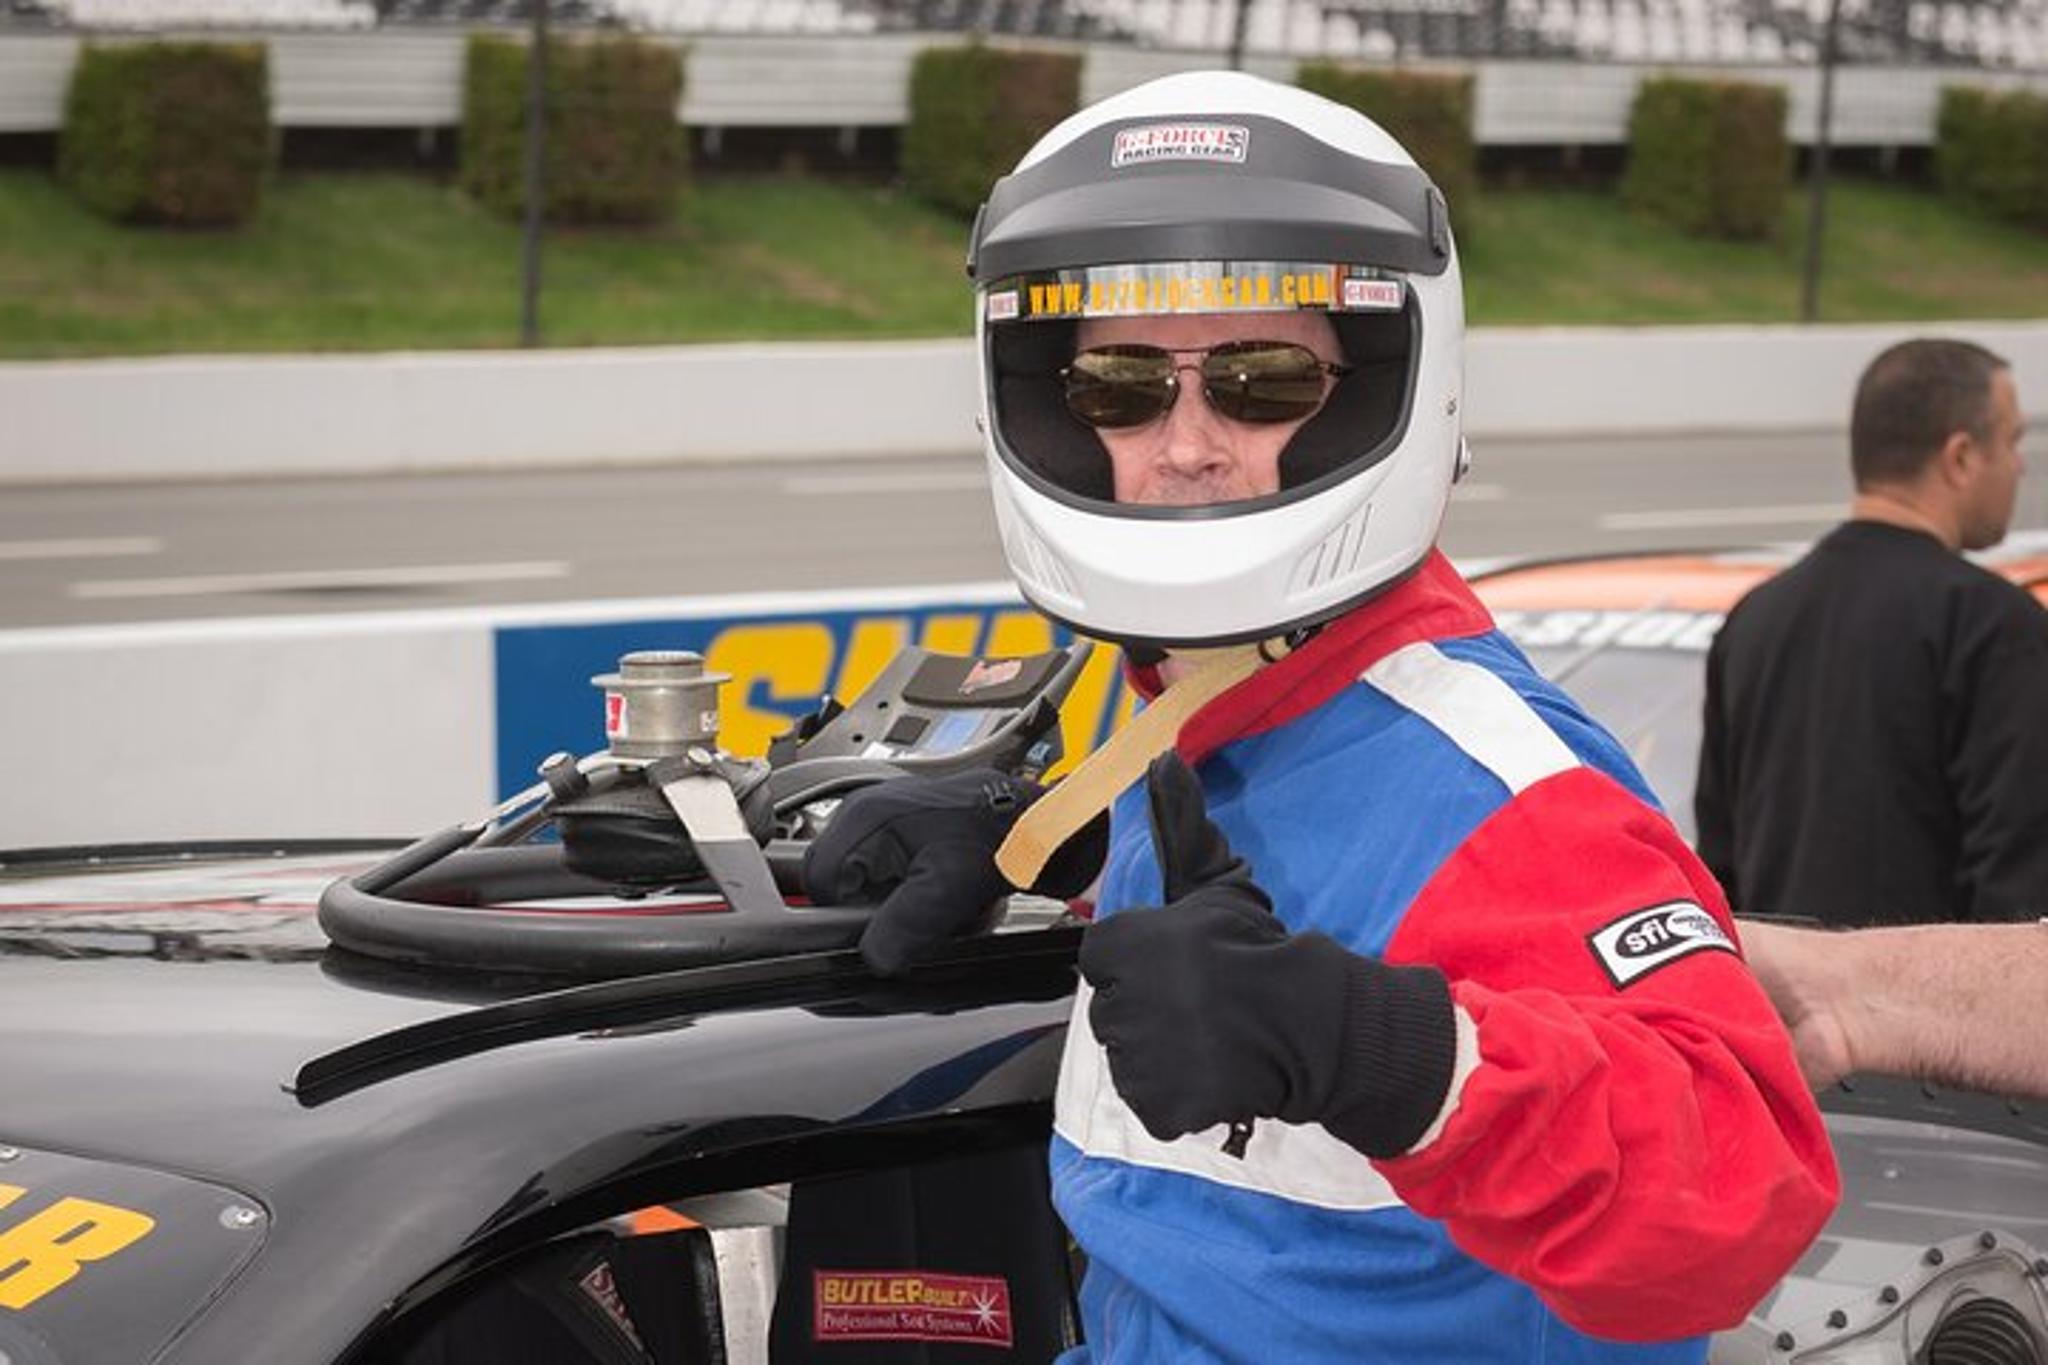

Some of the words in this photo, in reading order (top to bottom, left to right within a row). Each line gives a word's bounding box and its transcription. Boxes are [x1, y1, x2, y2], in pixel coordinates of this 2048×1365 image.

[1122, 144, 1187, 160] RACING
[1190, 143, 1235, 157] GEAR
[824, 1312, 897, 1332] Professional
